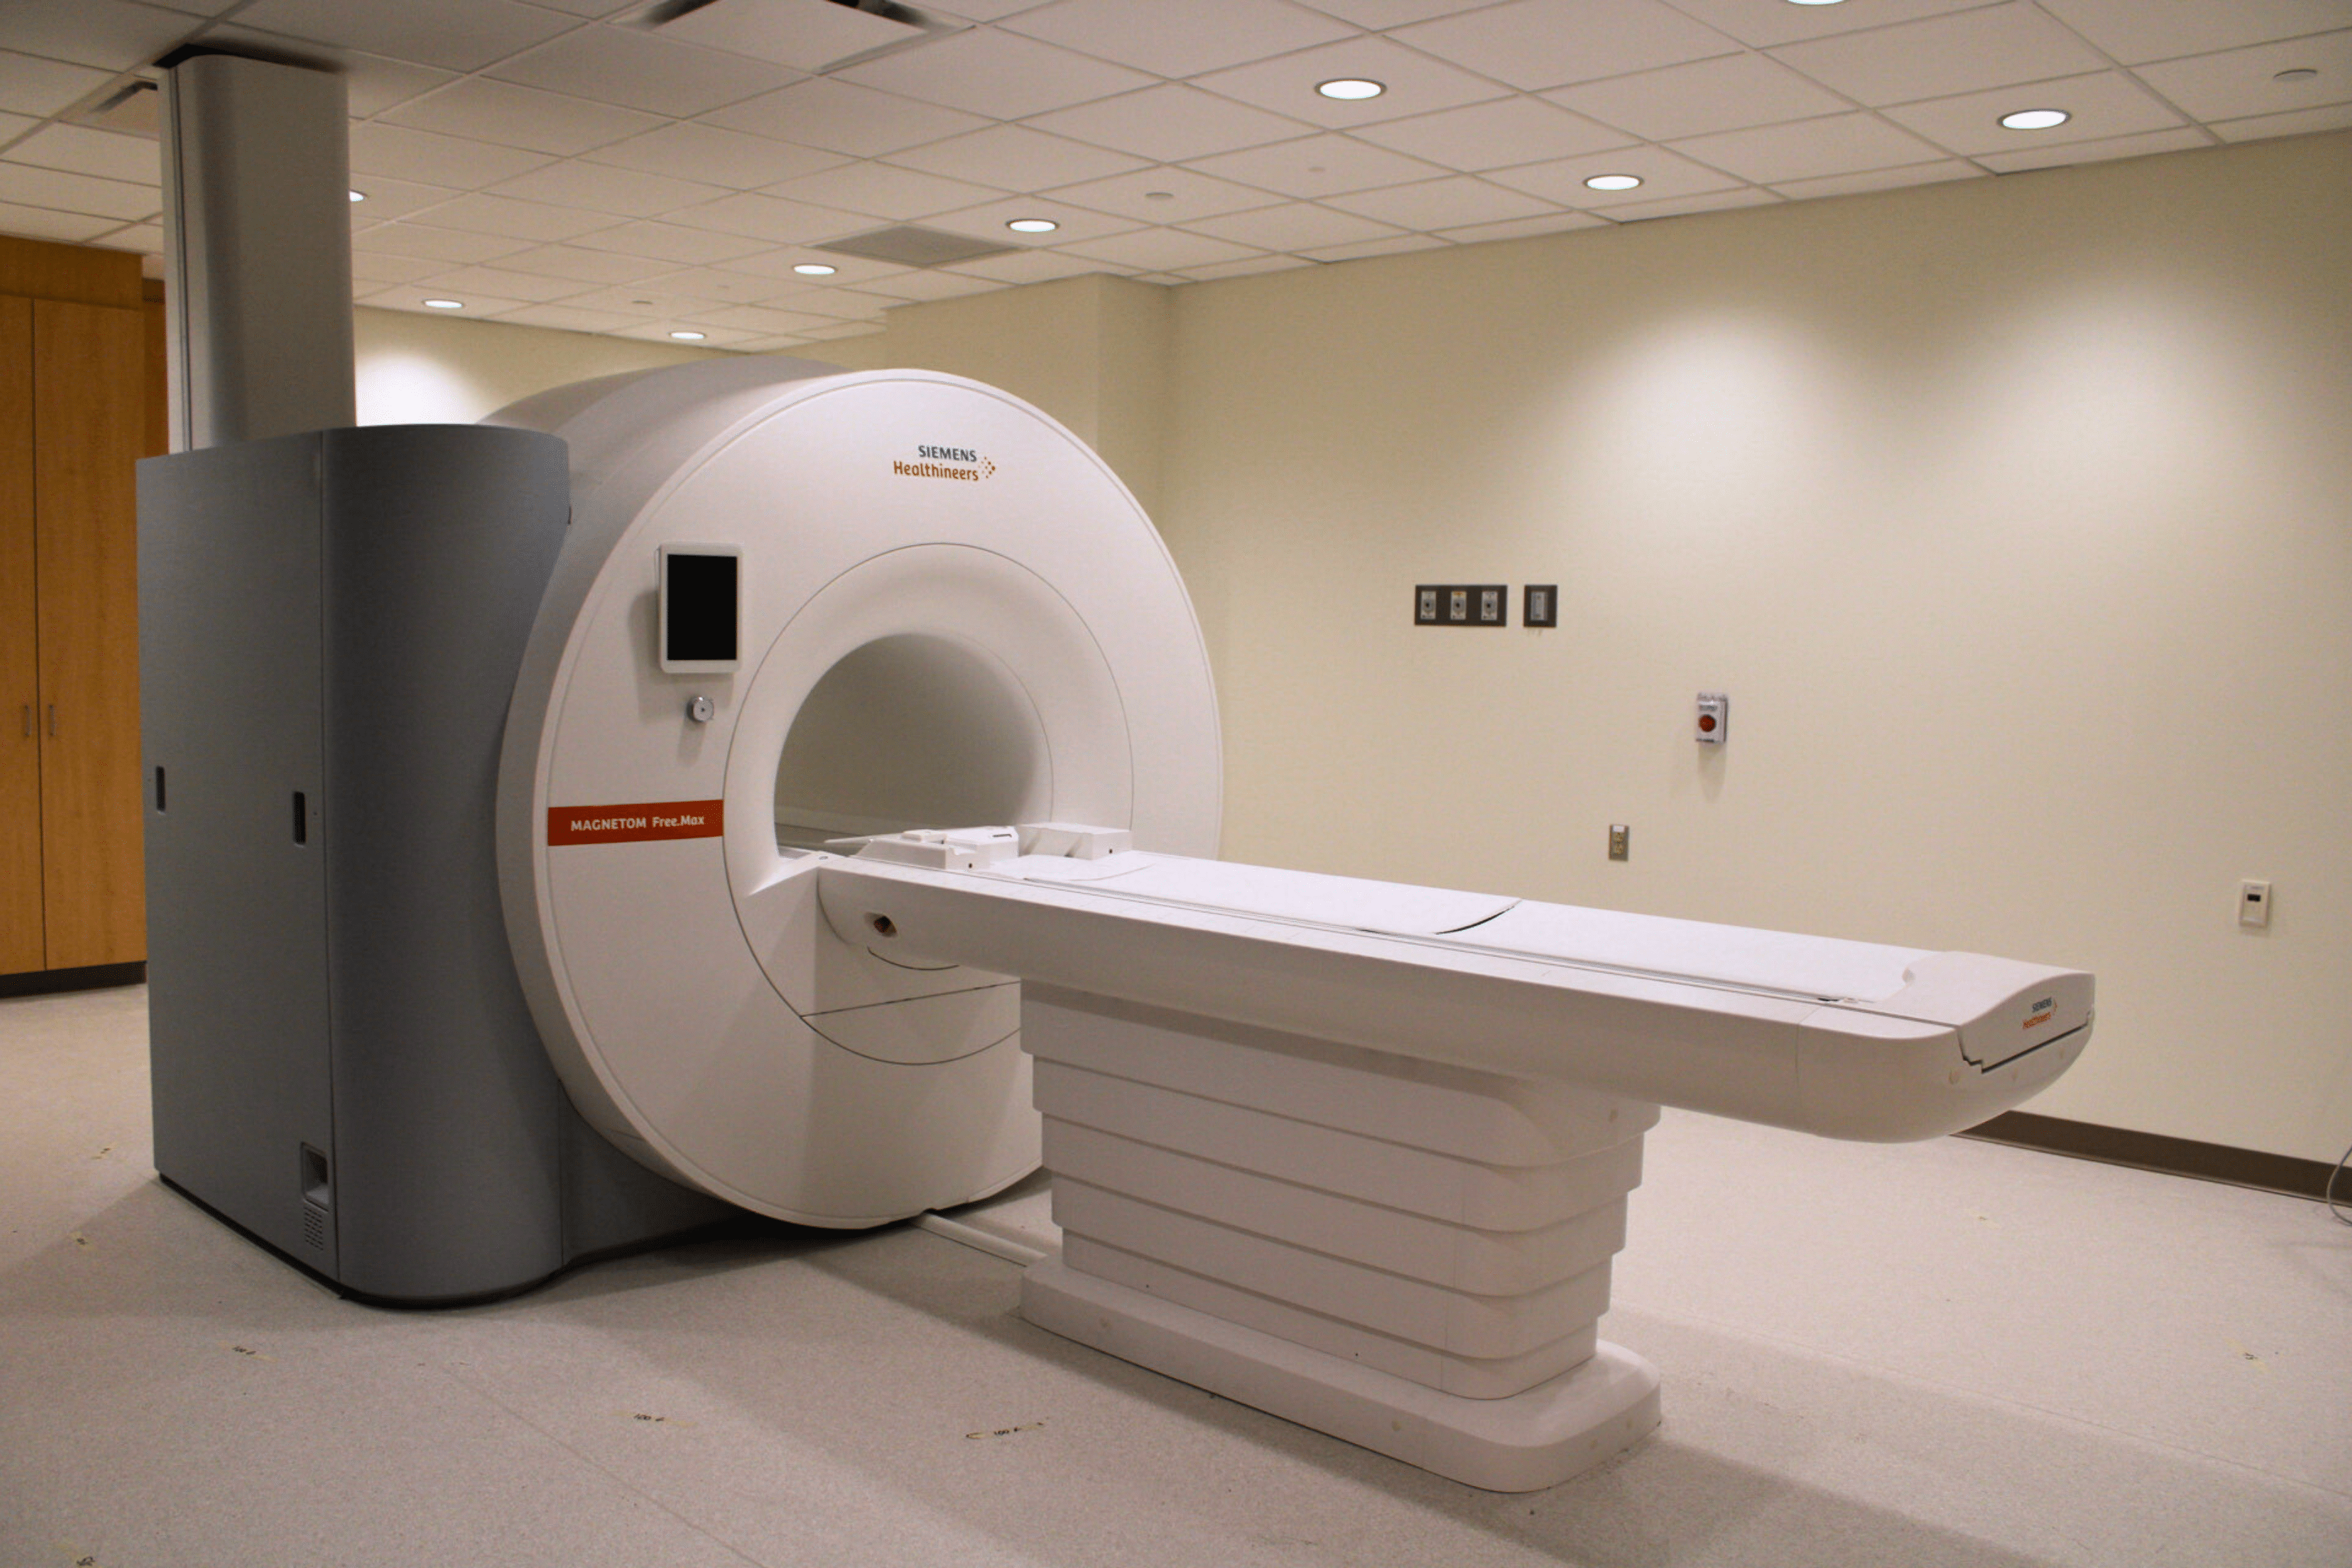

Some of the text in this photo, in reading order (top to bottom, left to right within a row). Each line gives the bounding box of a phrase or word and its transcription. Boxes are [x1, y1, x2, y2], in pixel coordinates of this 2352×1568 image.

[918, 445, 977, 463] SIEMENS
[894, 460, 979, 481] Healthineers
[571, 815, 705, 831] MAGNETOM Free.Max
